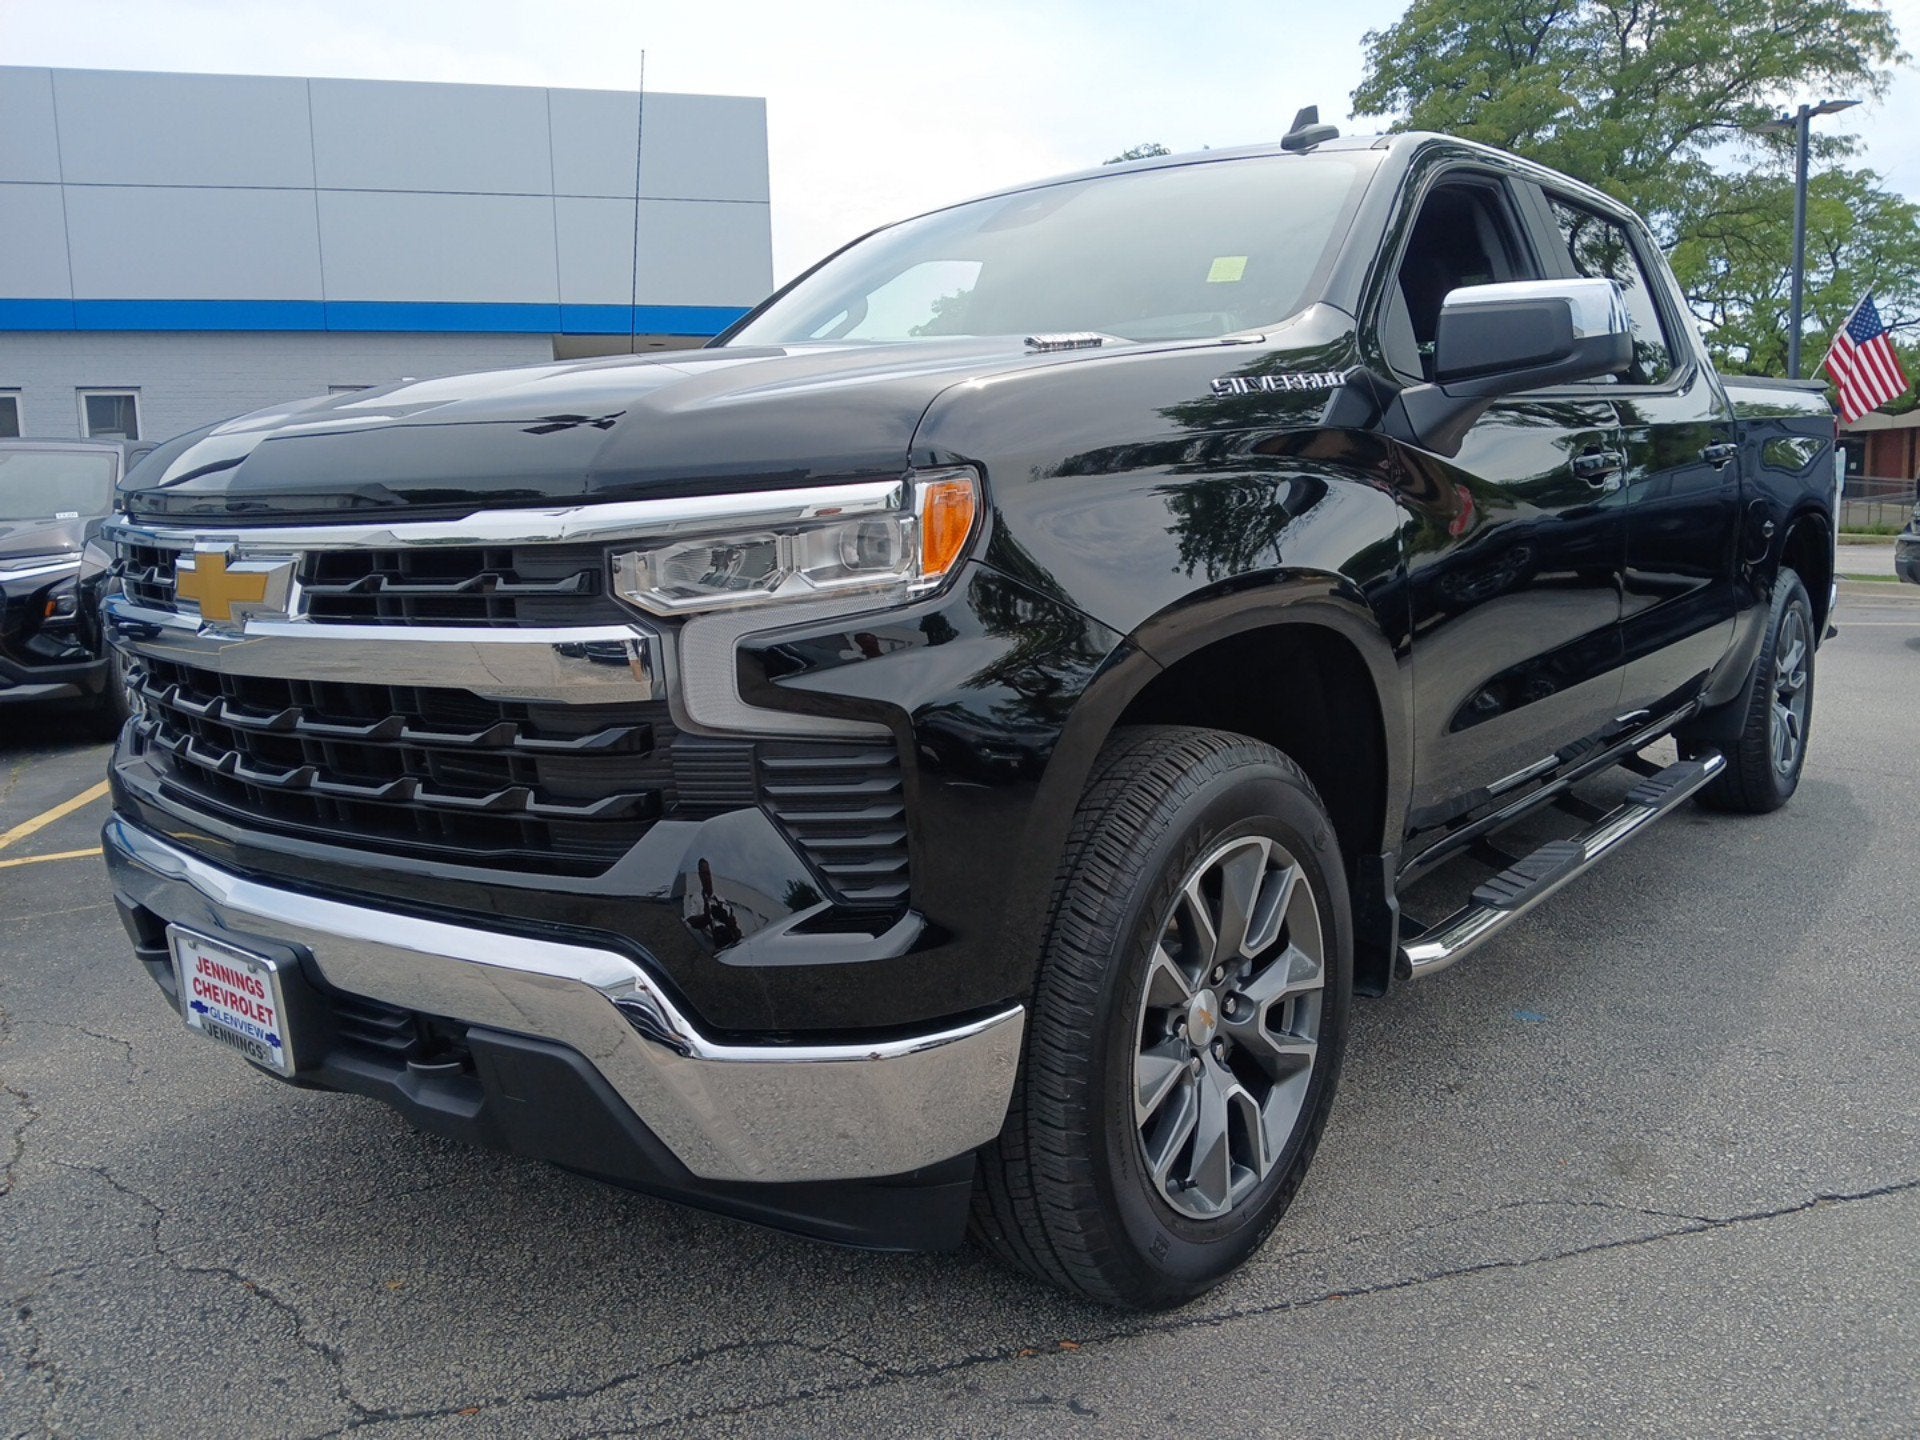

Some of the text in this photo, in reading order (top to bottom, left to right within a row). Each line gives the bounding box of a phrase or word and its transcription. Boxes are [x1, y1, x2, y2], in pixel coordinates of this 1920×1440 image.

[196, 955, 265, 1000] JENNINGS
[193, 976, 274, 1027] CHEVROLET
[206, 1025, 265, 1060] JENNINGS
[209, 1006, 266, 1040] GLENVIEW
